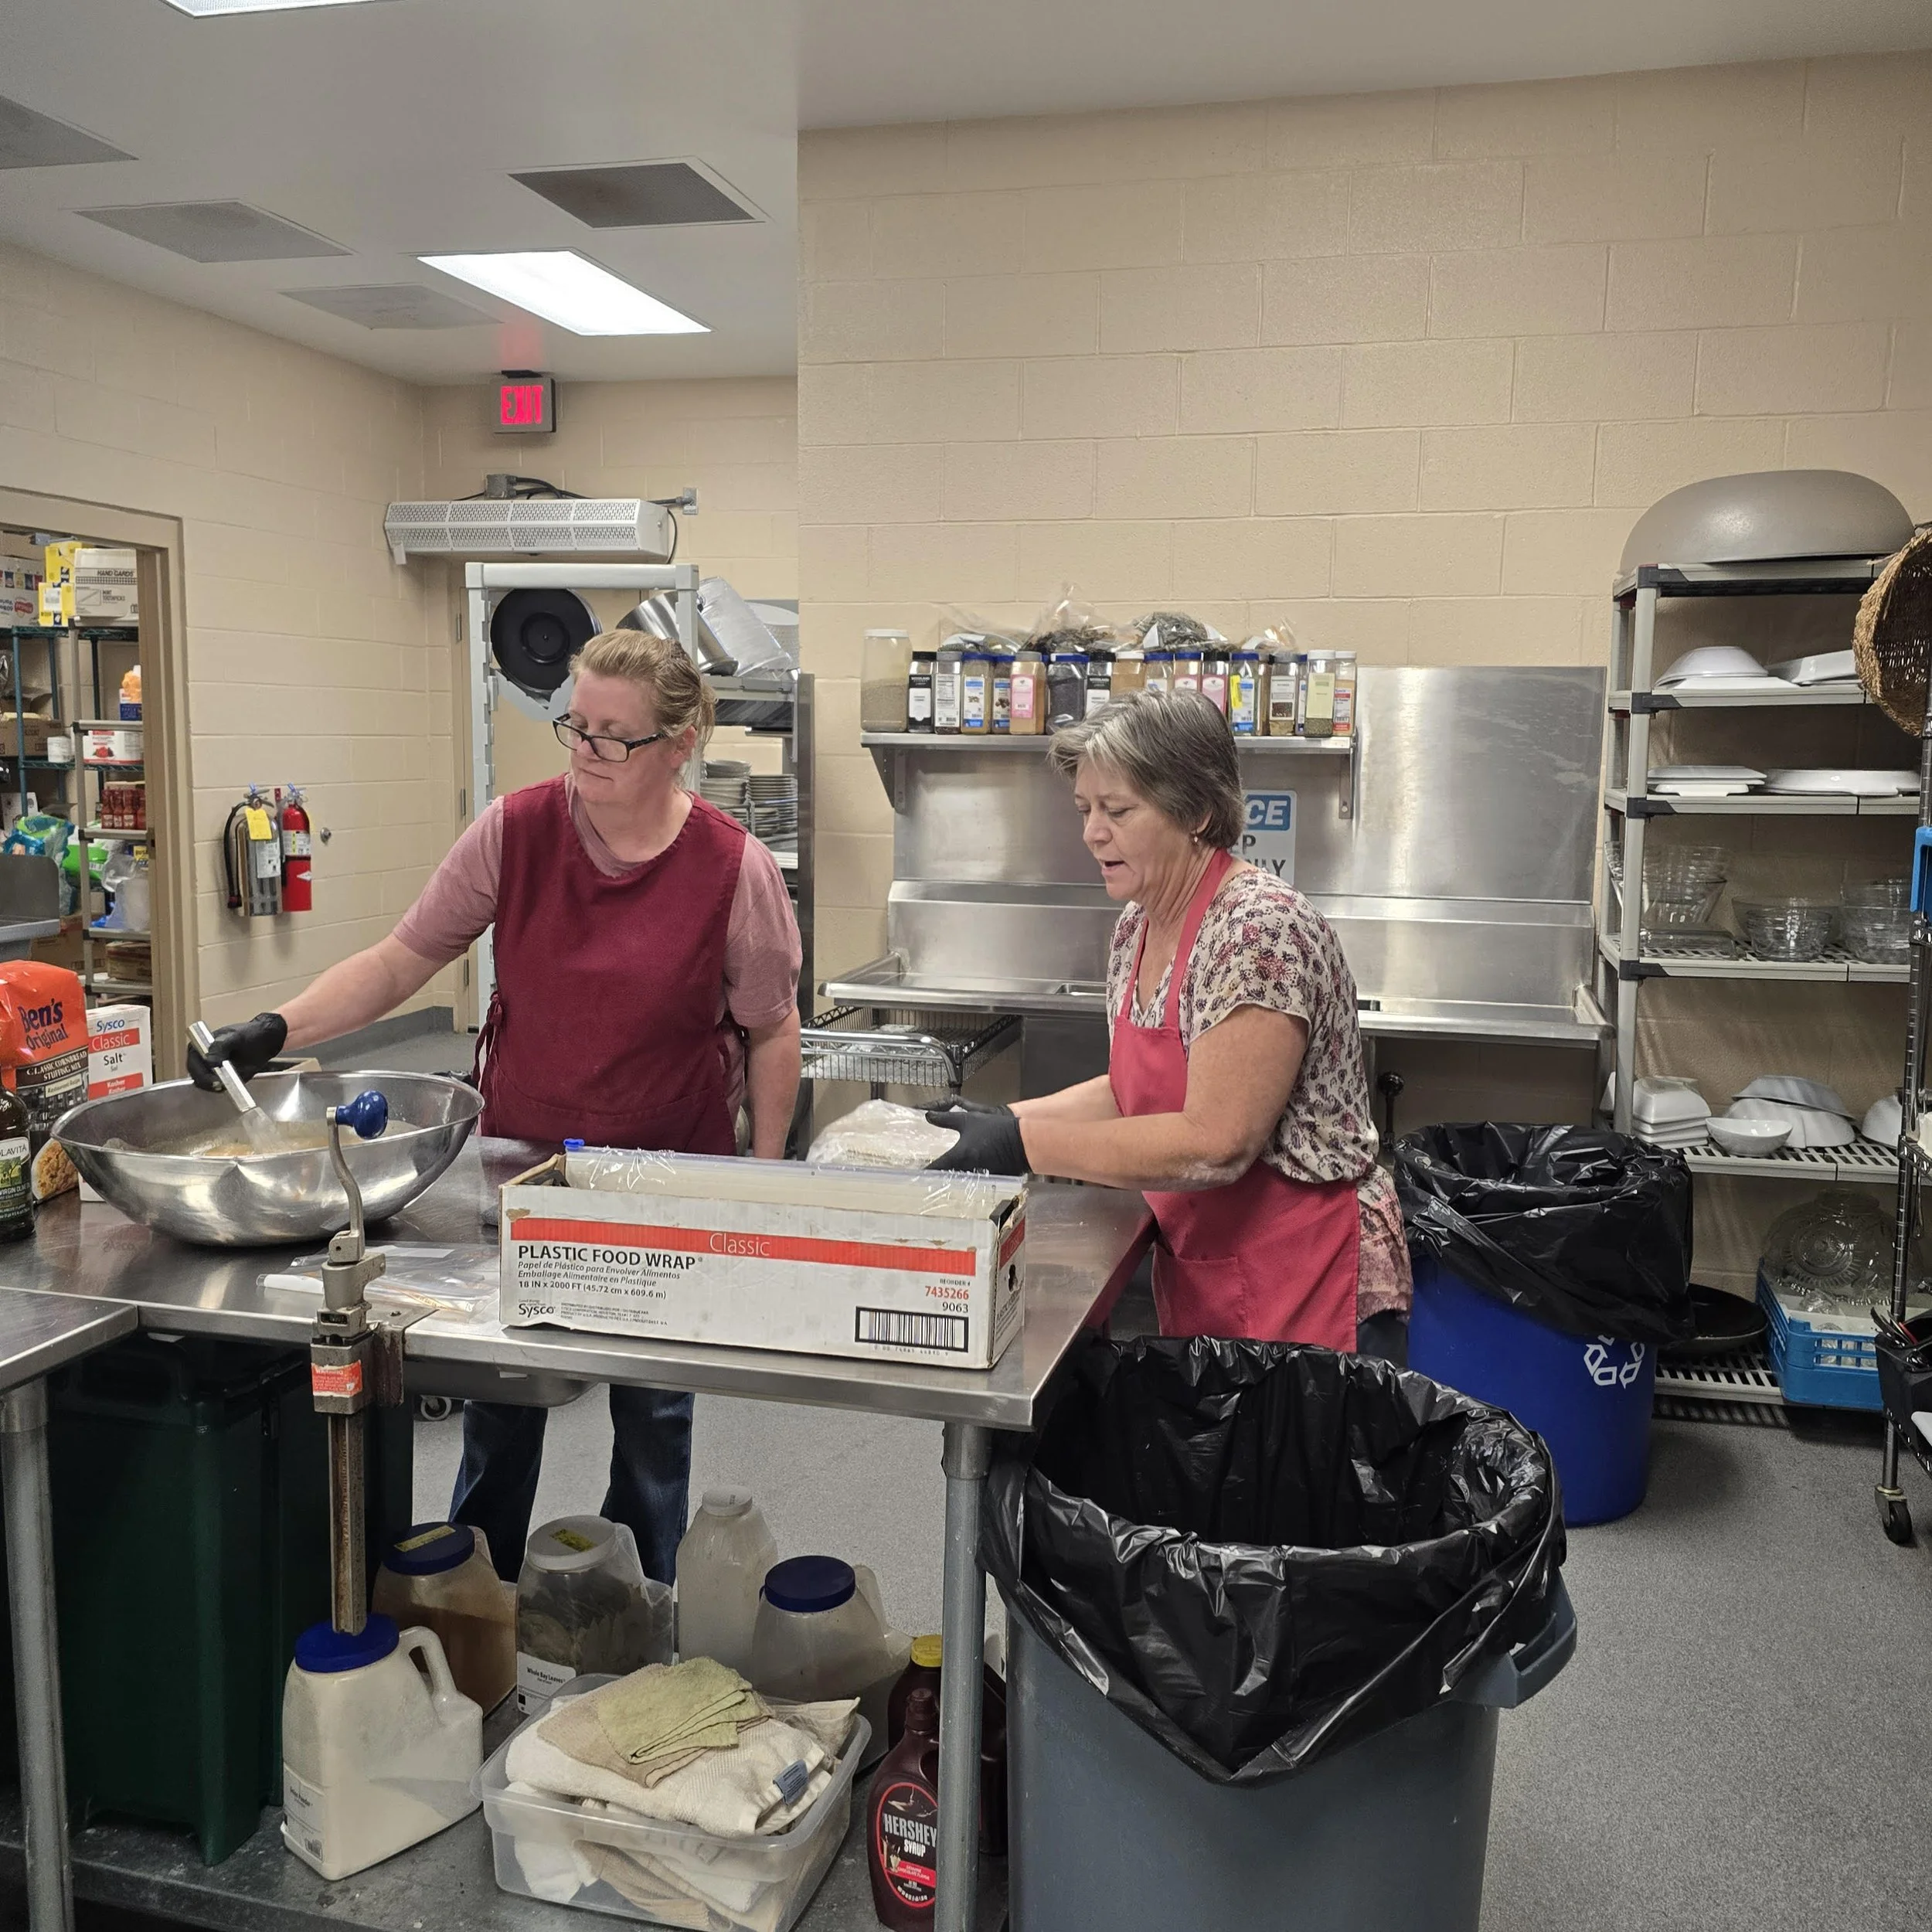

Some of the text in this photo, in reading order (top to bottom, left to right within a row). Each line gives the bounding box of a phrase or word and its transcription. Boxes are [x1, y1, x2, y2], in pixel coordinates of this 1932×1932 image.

[501, 385, 543, 424] EXIT
[18, 998, 63, 1033] Ben's
[97, 1019, 125, 1033] Sysco
[26, 1022, 68, 1050] Original
[92, 1032, 130, 1051] Classic
[26, 1051, 87, 1076] CLASSIC CORNBREAD
[104, 1053, 123, 1066] Salt
[43, 1066, 70, 1081] STUFFING
[0, 1144, 27, 1157] LAVITA
[710, 1233, 770, 1256] Classic
[519, 1245, 587, 1261] PLASTIC
[593, 1249, 641, 1266] FOOD
[518, 1261, 541, 1270] Papel
[554, 1262, 584, 1271] Plástico
[606, 1266, 639, 1276] Envolver
[641, 1269, 680, 1280] Alimentos
[518, 1270, 561, 1280] Emballage
[563, 1271, 608, 1283] Alimentaire
[621, 1277, 656, 1287] Plastique
[550, 1281, 570, 1290] 2000
[583, 1284, 609, 1294] (45.72
[631, 1288, 654, 1298] 609.6
[656, 1291, 666, 1300] m)
[925, 1286, 969, 1300] 7435266
[519, 1303, 554, 1318] Sysco
[942, 1301, 969, 1314] 9063
[904, 1838, 926, 1858] SYRUP
